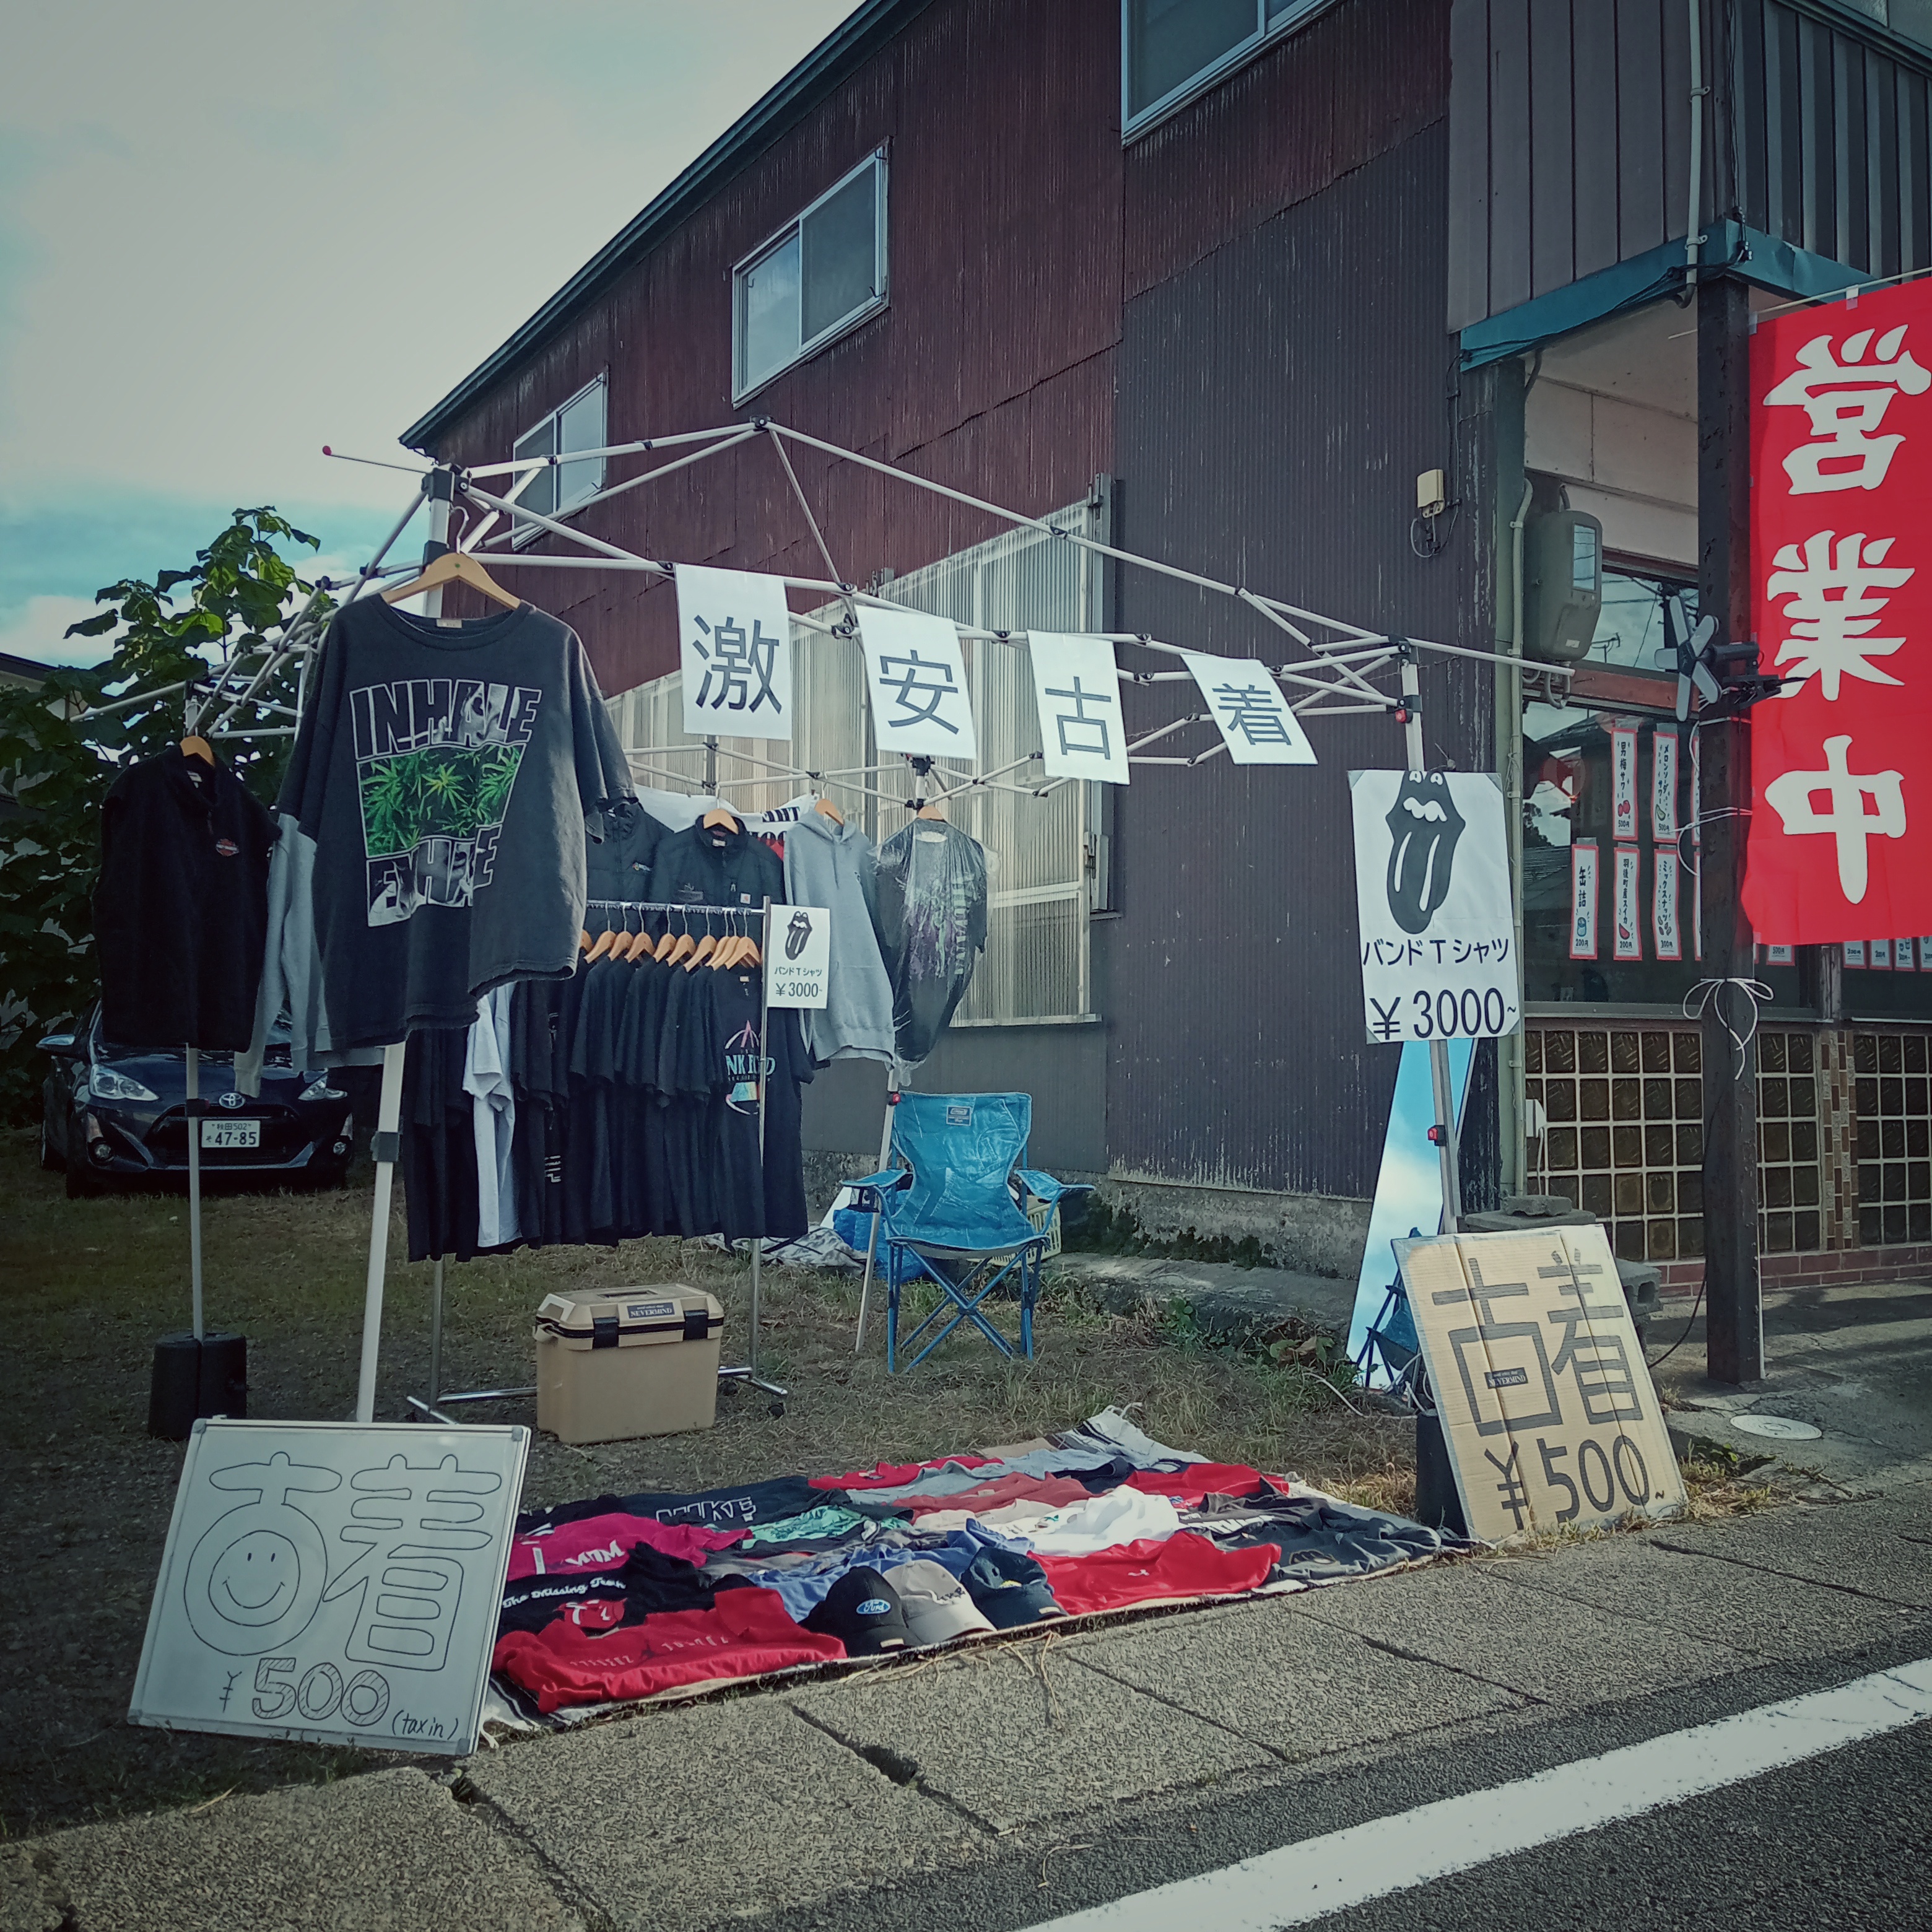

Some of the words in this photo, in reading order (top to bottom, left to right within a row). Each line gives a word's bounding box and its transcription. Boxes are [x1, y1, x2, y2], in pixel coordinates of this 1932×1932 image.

[1762, 323, 1931, 905] 営業中
[350, 679, 542, 760] INHALE
[1578, 866, 1586, 907] 缶詰
[1363, 939, 1509, 965] バンドTシャツ
[774, 966, 822, 977] バンドTシャツ
[215, 1131, 257, 1145] 47-85
[630, 1307, 672, 1316] NEVERMIND
[1432, 1248, 1643, 1437] 古着
[184, 1451, 502, 1671] 古着
[502, 1595, 529, 1608] The
[863, 1601, 885, 1612] Ford
[219, 1658, 390, 1726] ¥500
